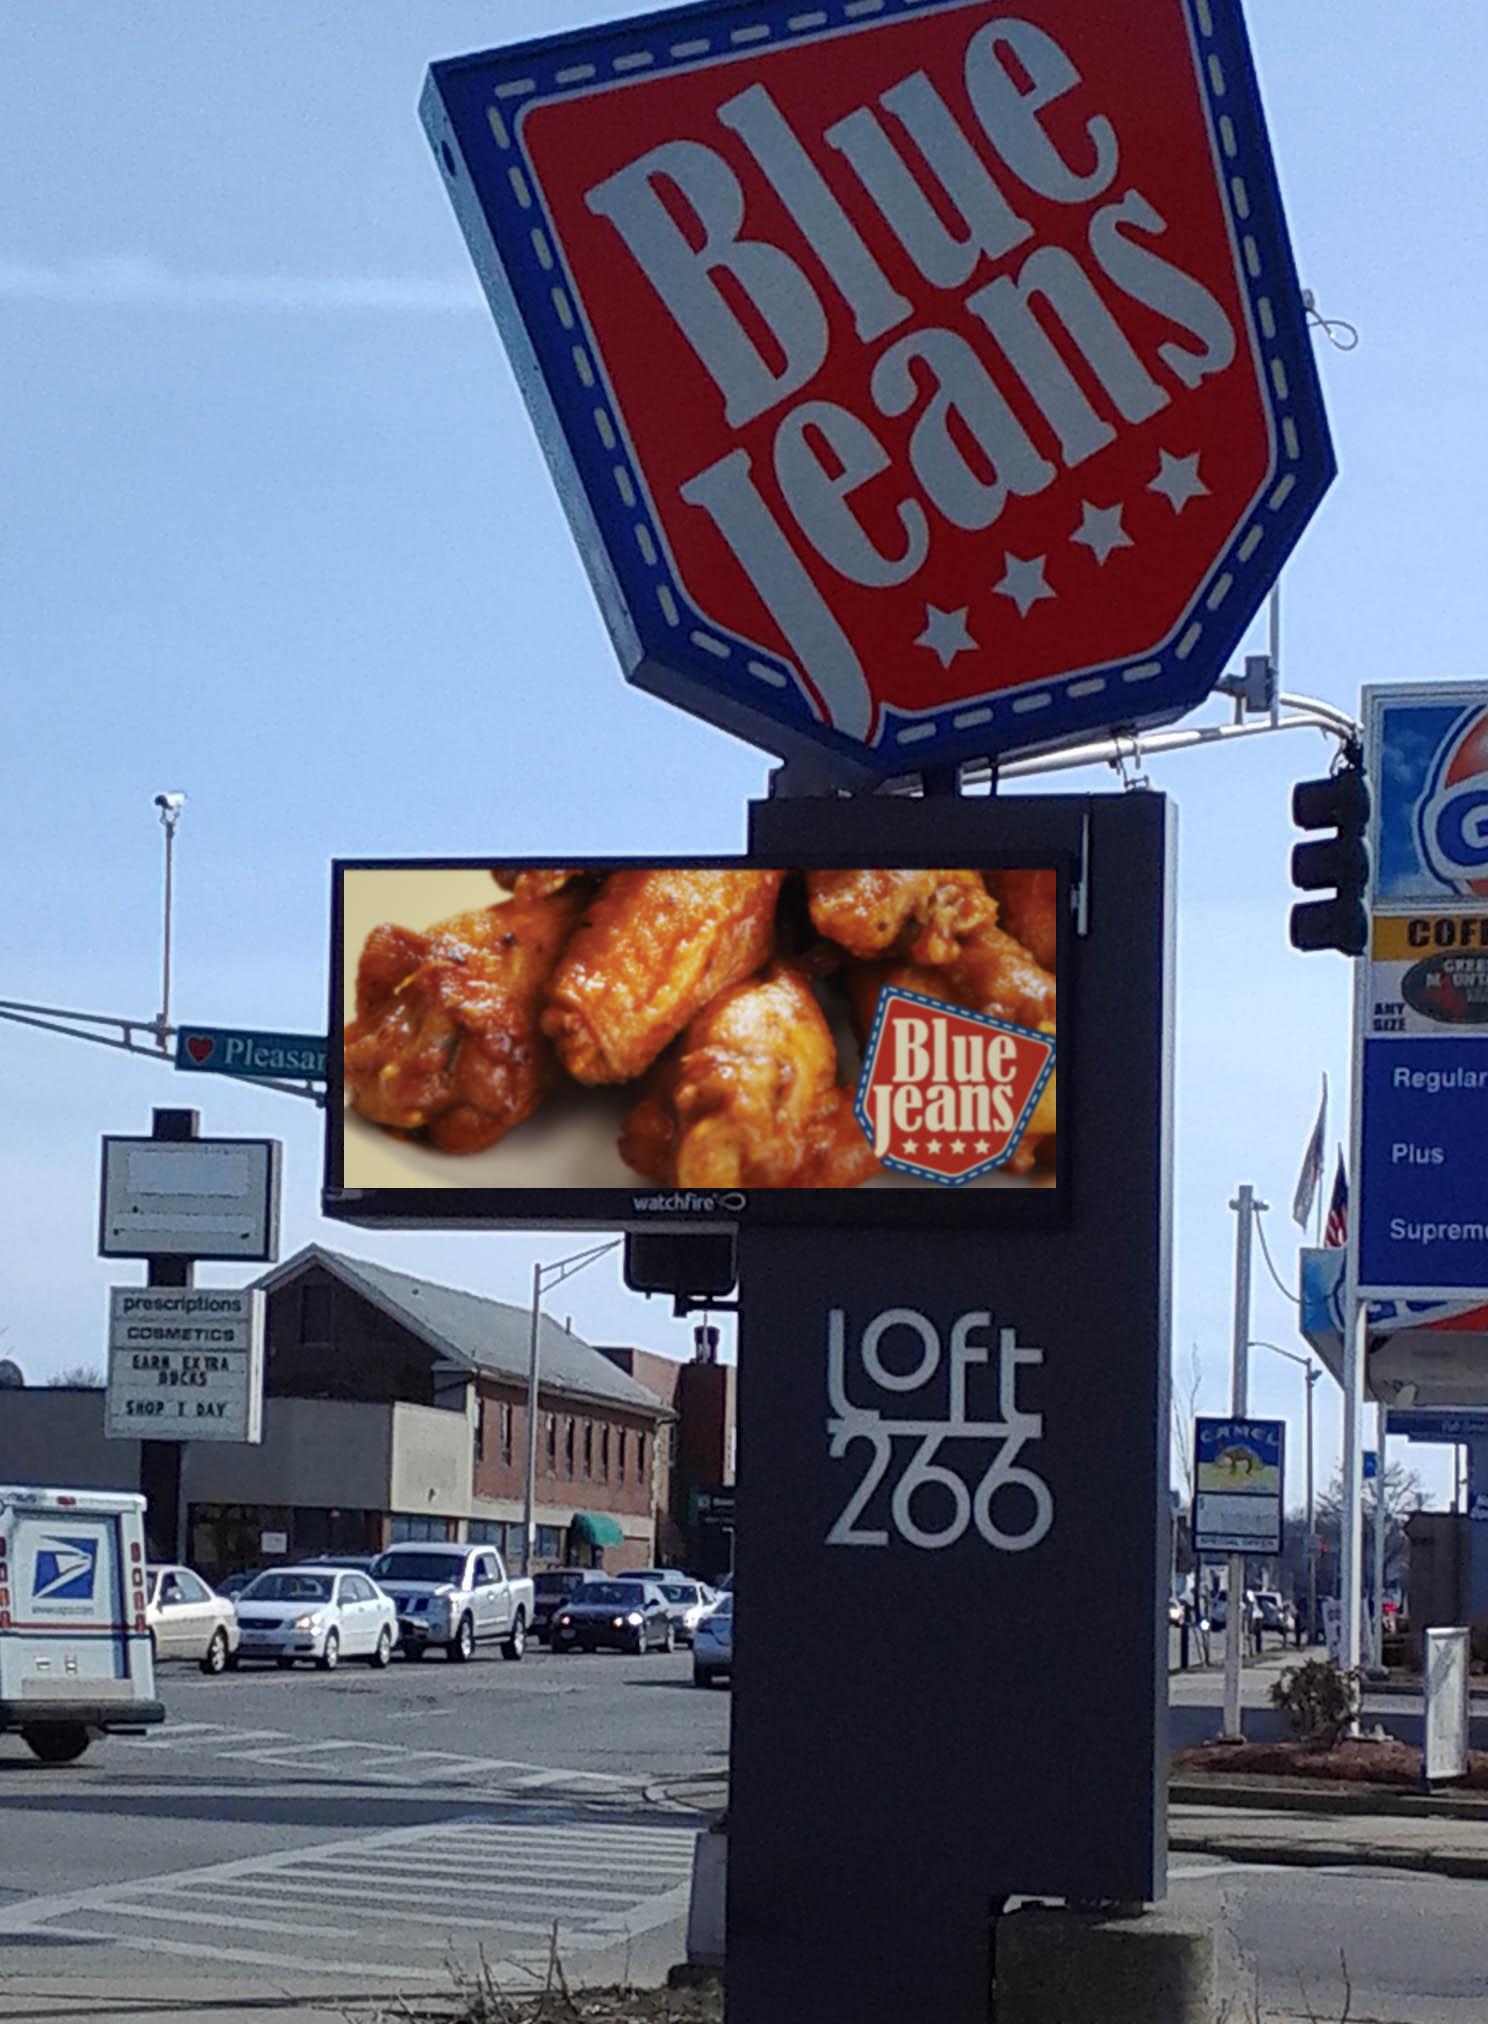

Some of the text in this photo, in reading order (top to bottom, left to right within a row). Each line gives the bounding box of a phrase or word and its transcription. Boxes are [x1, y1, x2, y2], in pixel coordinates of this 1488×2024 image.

[583, 17, 1119, 430] Blue
[679, 189, 1236, 747] Jeans
[892, 1018, 1017, 1083] Blue
[1393, 1067, 1488, 1093] Regular
[872, 1084, 1014, 1158] Jeans
[1391, 1143, 1445, 1164] Plus
[633, 1192, 715, 1211] watchfire
[123, 1297, 241, 1314] prescriptions
[127, 1326, 235, 1342] COSMETICS
[824, 1420, 1054, 1551] 266
